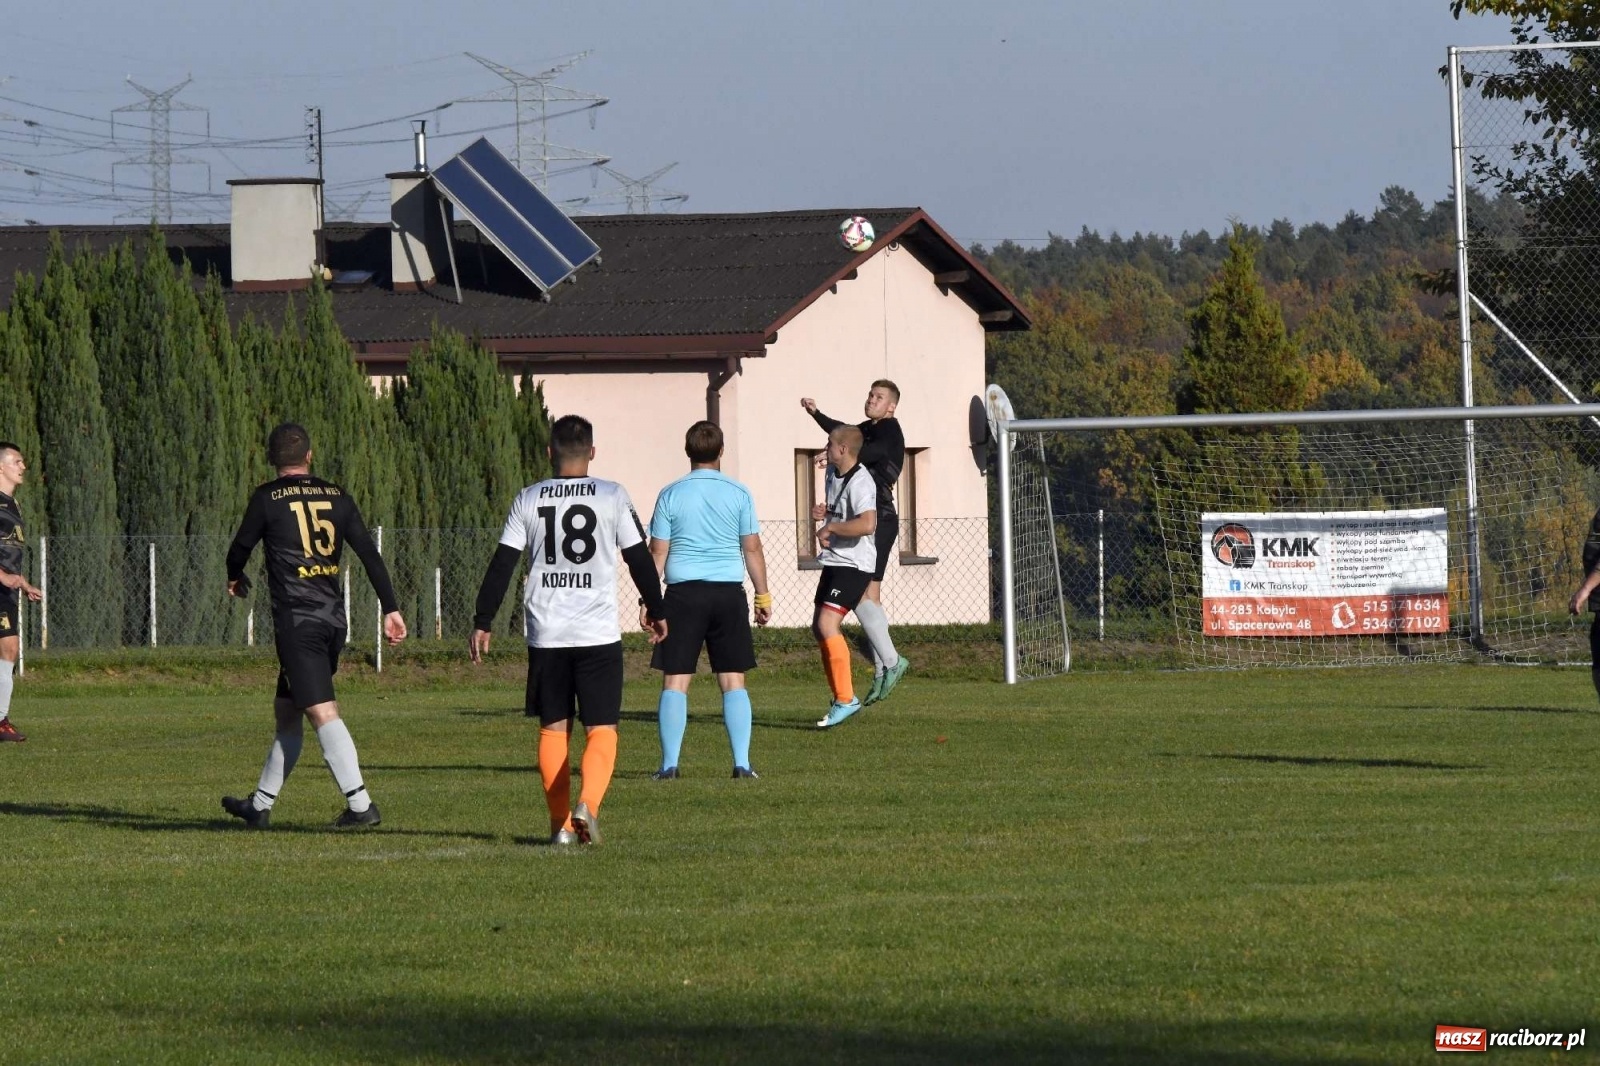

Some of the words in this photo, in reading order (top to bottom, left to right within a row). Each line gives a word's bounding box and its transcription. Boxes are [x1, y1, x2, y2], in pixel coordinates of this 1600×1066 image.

[271, 486, 300, 500] CZARNI
[302, 486, 323, 495] NOWA
[540, 482, 596, 498] PŁOMIEŃ
[289, 501, 335, 558] 15
[537, 504, 597, 565] 18
[1262, 537, 1320, 557] KMK
[1336, 547, 1362, 555] wykopy
[1267, 560, 1316, 570] Transkop
[1336, 556, 1369, 564] niwelacja
[542, 572, 592, 588] KOBYLA
[1244, 582, 1266, 590] KMK
[1268, 581, 1308, 591] Transkop
[1337, 581, 1377, 589] wyburzenia
[1210, 604, 1252, 615] 44-285
[1256, 604, 1296, 617] Kobyla
[1211, 620, 1225, 630] ul.
[1228, 620, 1293, 631] Spacerowa
[1297, 619, 1312, 629] 4B
[1363, 616, 1441, 630] 534627102
